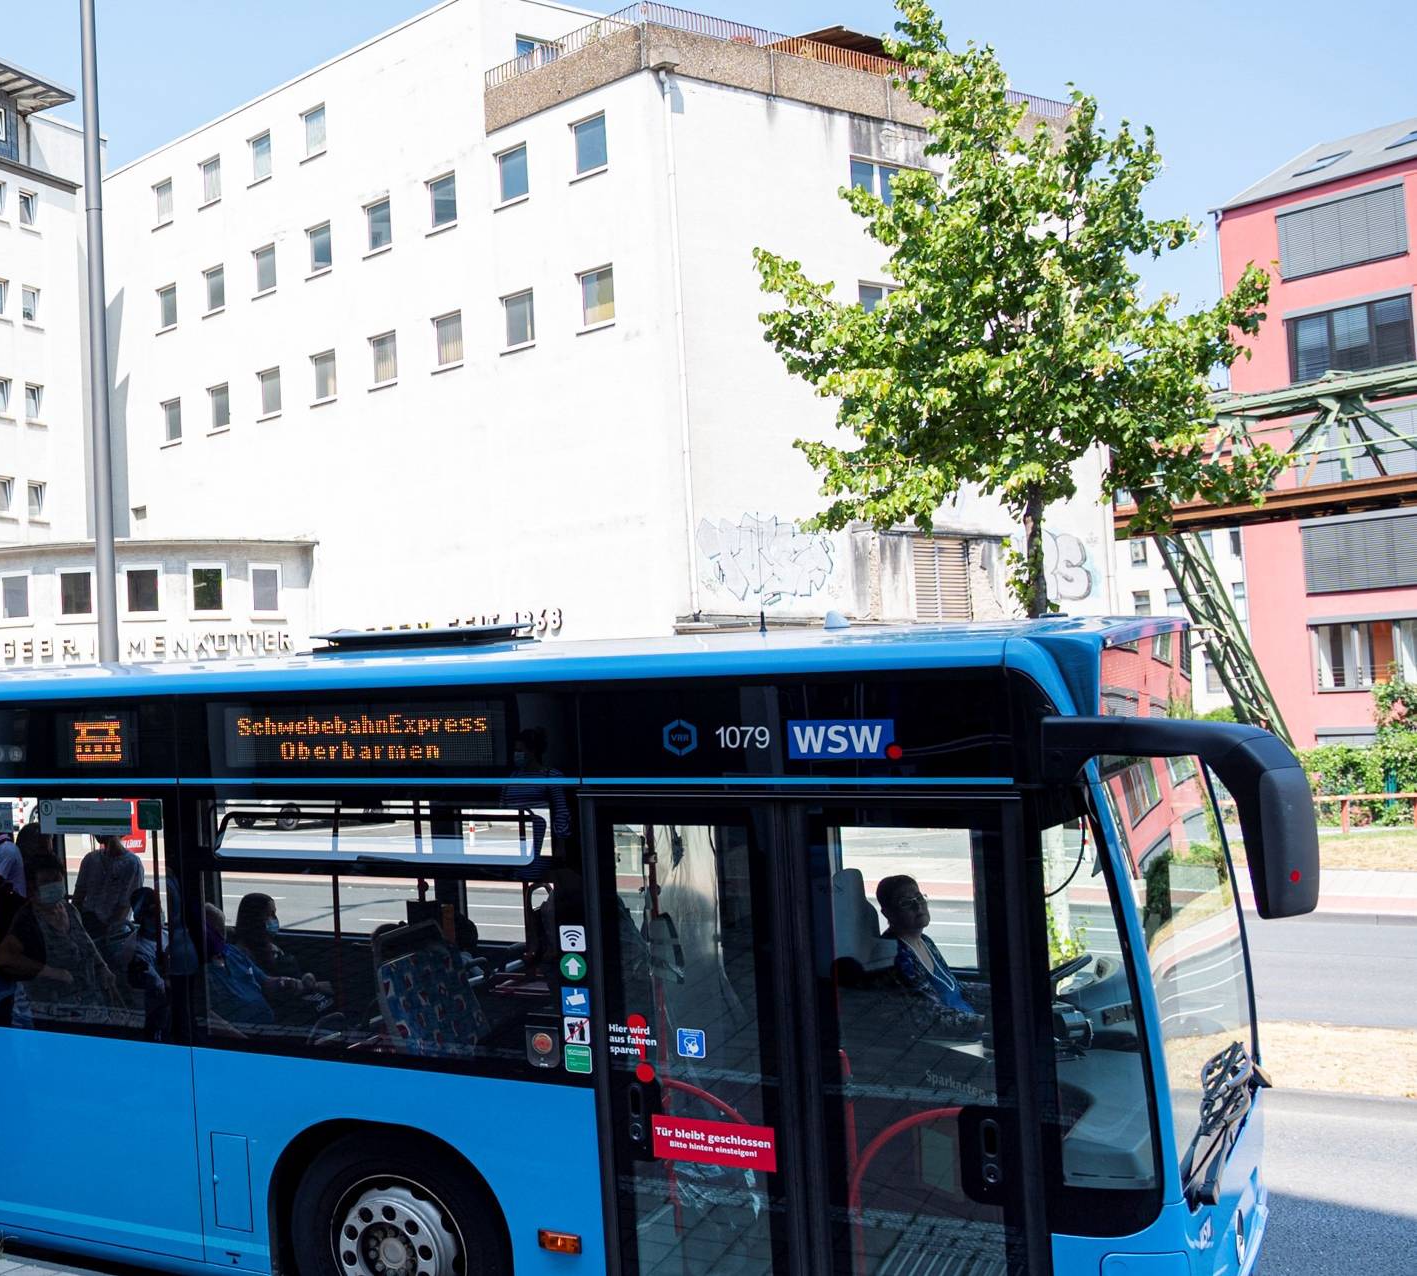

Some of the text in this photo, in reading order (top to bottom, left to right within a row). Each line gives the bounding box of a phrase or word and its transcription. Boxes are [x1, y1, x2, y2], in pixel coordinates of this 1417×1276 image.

[236, 714, 488, 738] SchwebebahnExpress
[671, 733, 690, 743] VRR
[715, 726, 771, 749] 1079
[793, 724, 883, 754] WSW
[280, 741, 441, 761] Oberbarmen
[608, 1023, 650, 1035] Hier wird
[608, 1035, 657, 1047] aus fahren
[609, 1046, 641, 1056] sparen
[925, 1069, 987, 1100] Sparkarten
[655, 1126, 771, 1149] Tür bleibt geschlossen
[669, 1140, 758, 1158] Bitte hinten einsteigen!
